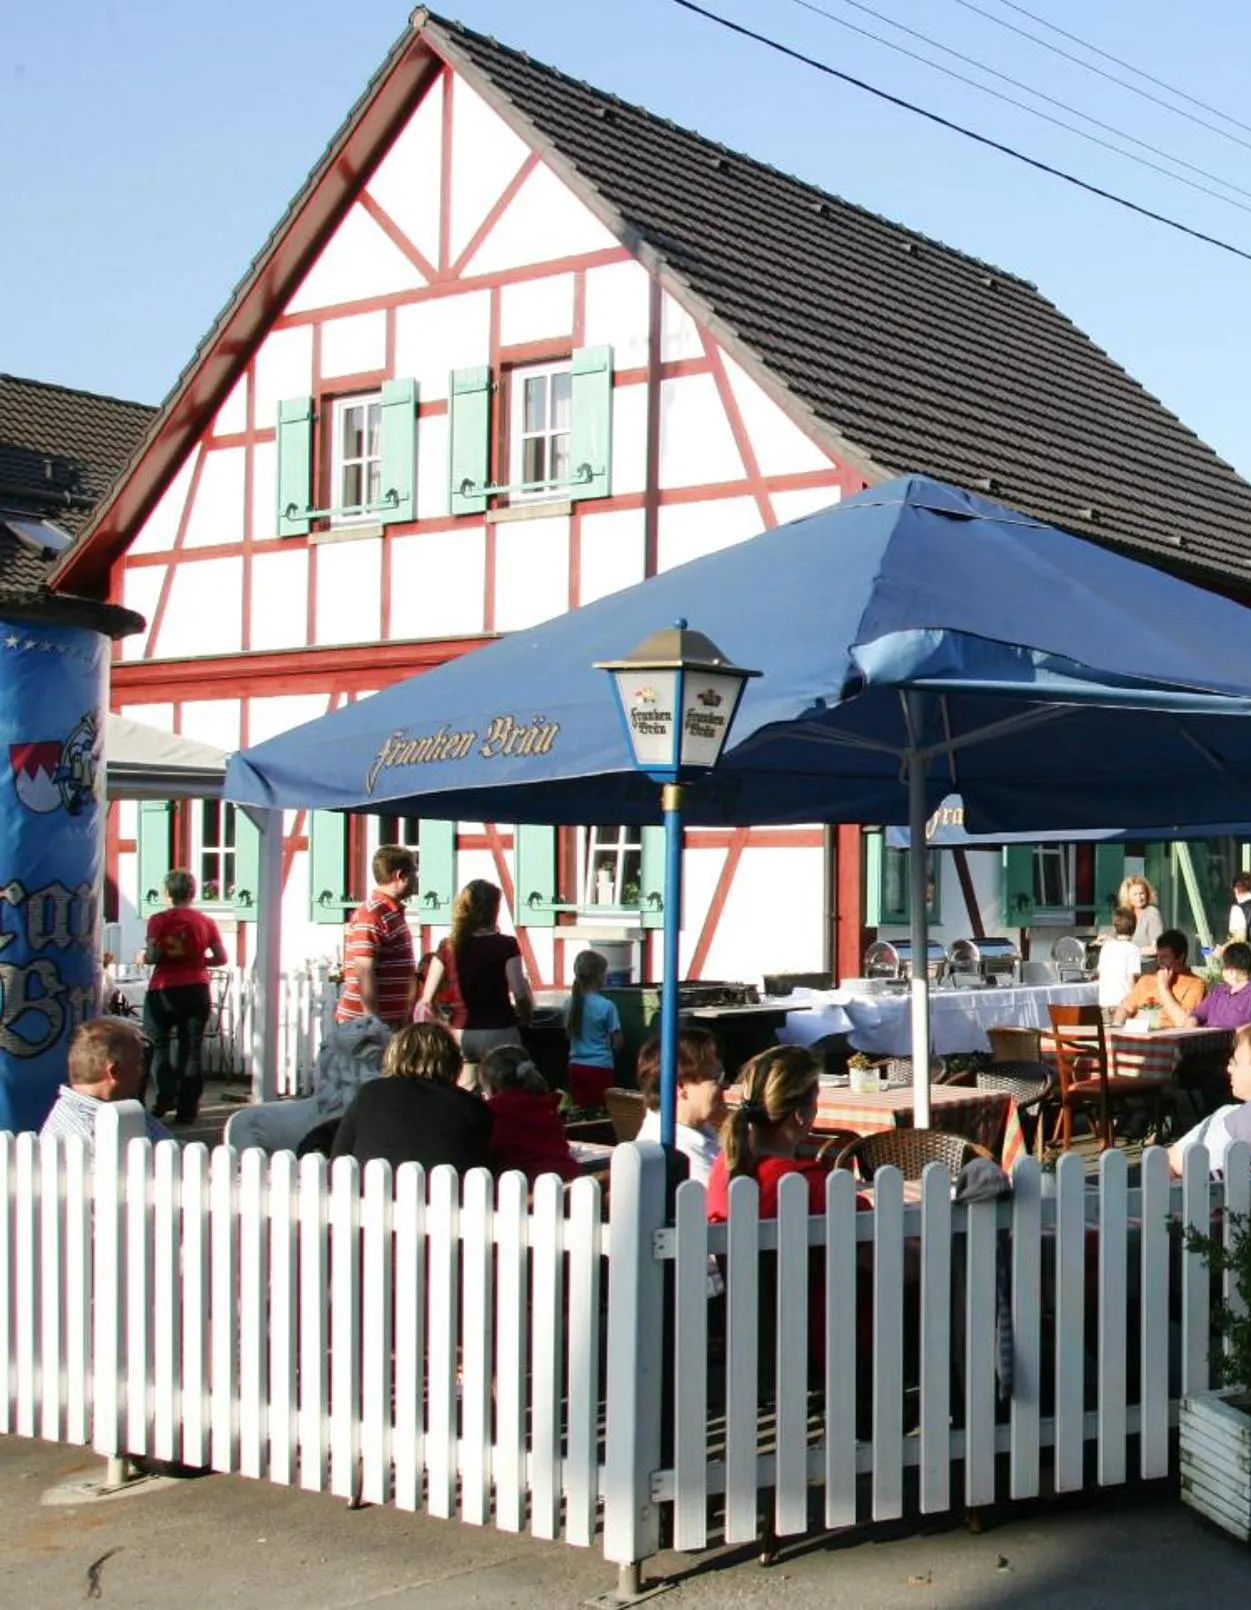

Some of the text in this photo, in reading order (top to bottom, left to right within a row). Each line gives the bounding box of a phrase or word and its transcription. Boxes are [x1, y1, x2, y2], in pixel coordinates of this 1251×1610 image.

[630, 706, 673, 729] Franken
[366, 724, 477, 796] Franken
[480, 714, 561, 759] Bräu
